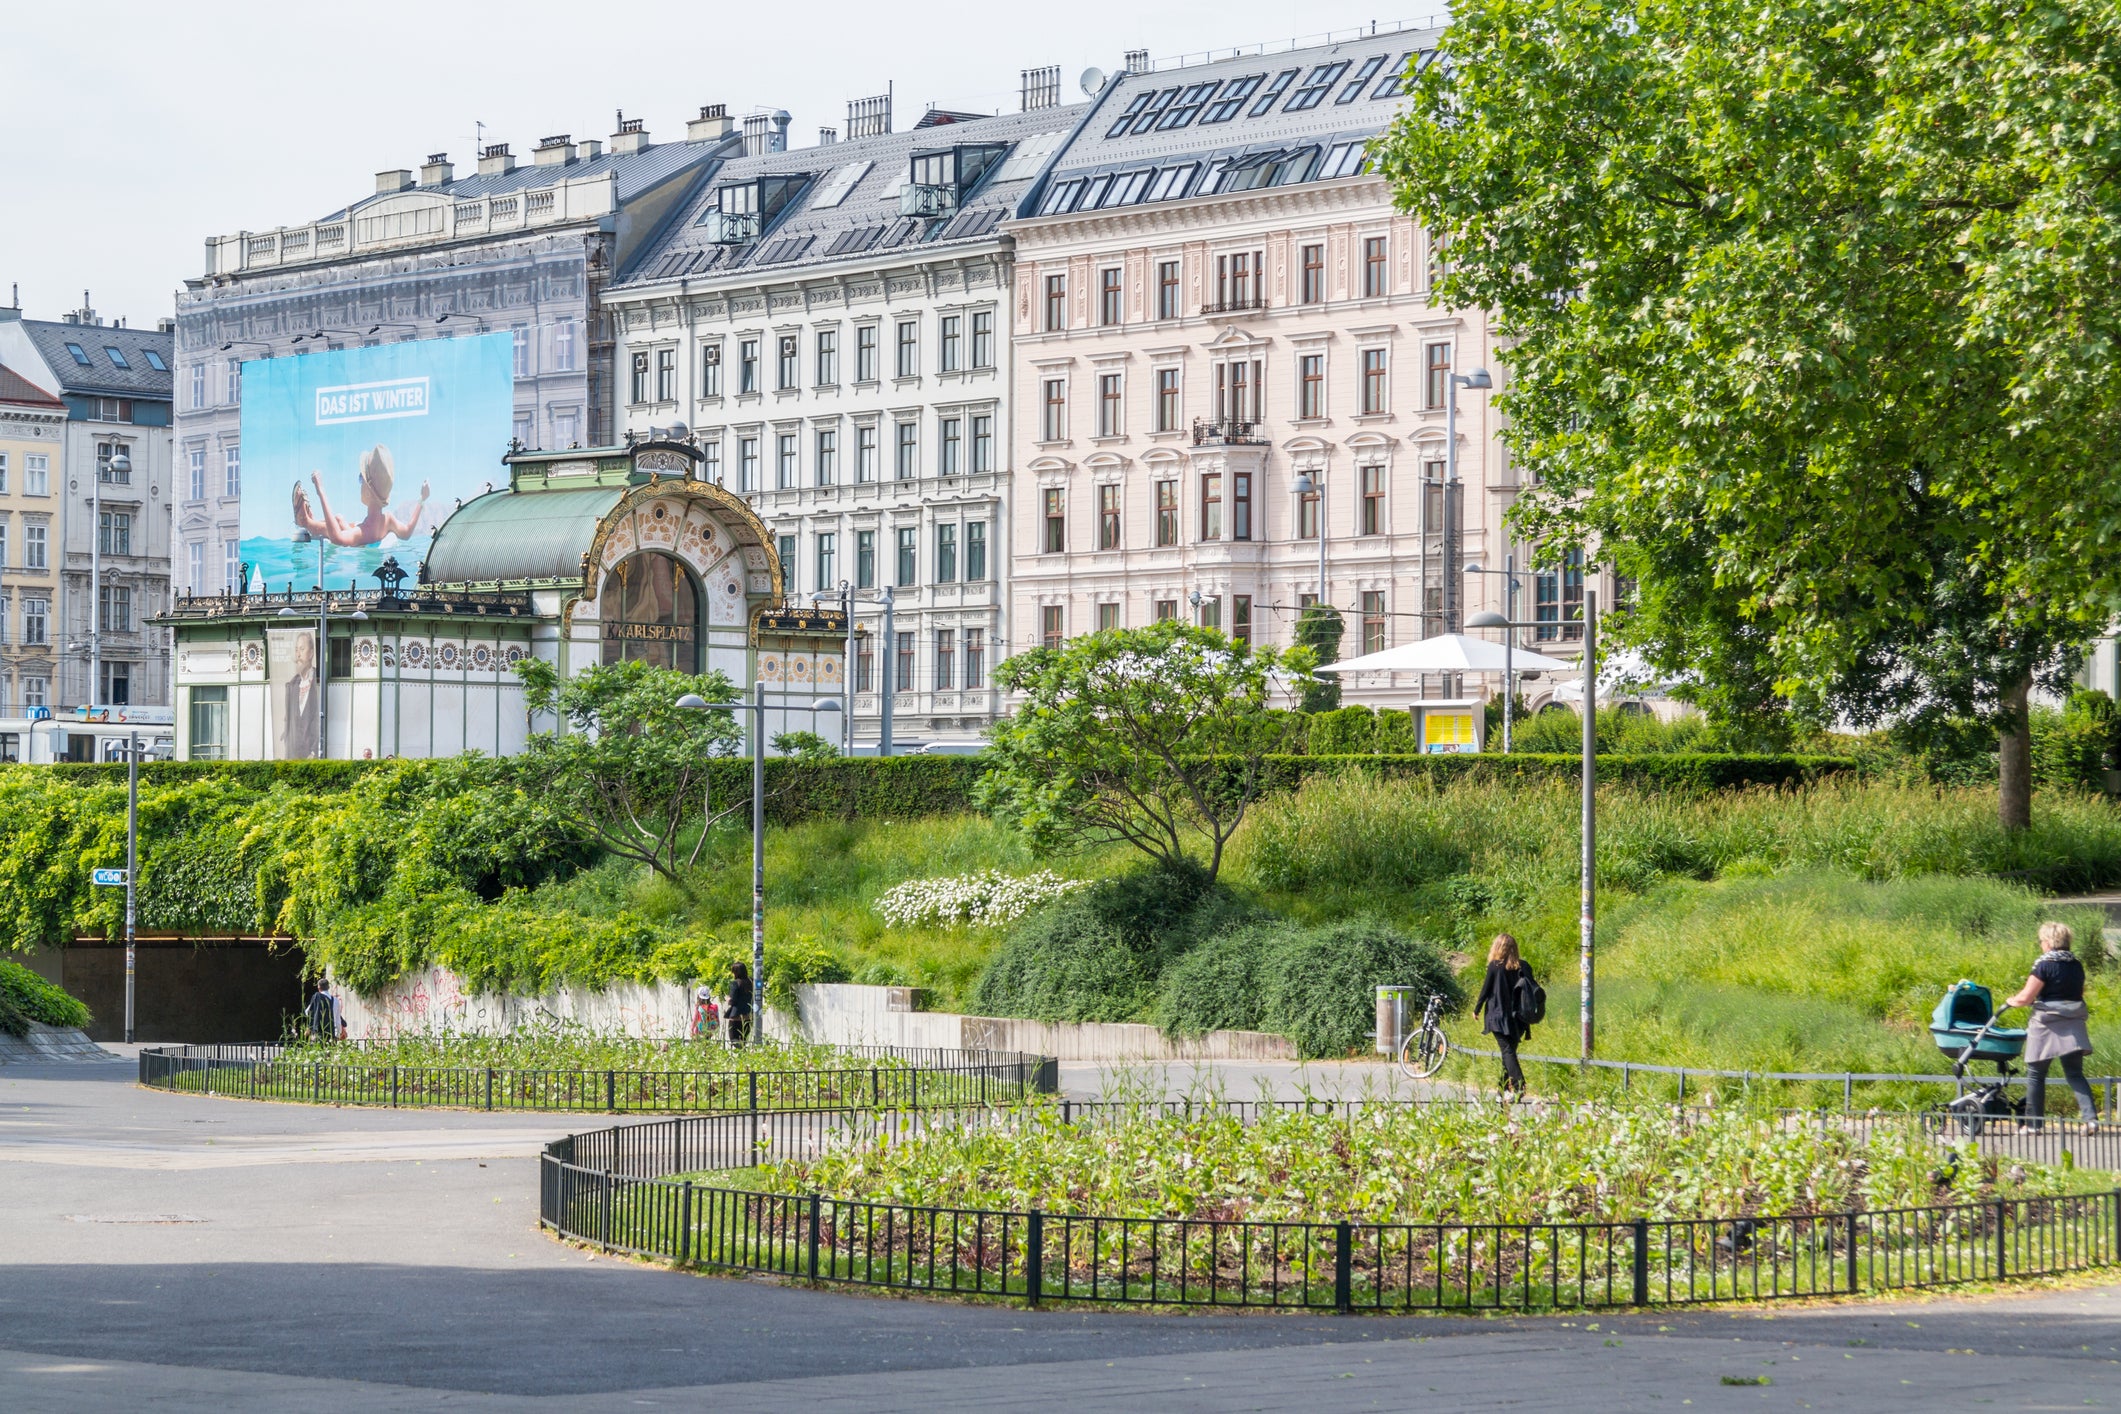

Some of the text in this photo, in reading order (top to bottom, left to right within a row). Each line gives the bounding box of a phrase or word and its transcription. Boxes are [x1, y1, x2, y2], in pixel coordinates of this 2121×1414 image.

[320, 387, 424, 416] DAS IST WINTER
[1447, 528, 1462, 587] Karlsplatz
[617, 623, 690, 640] KARLSPLATZ
